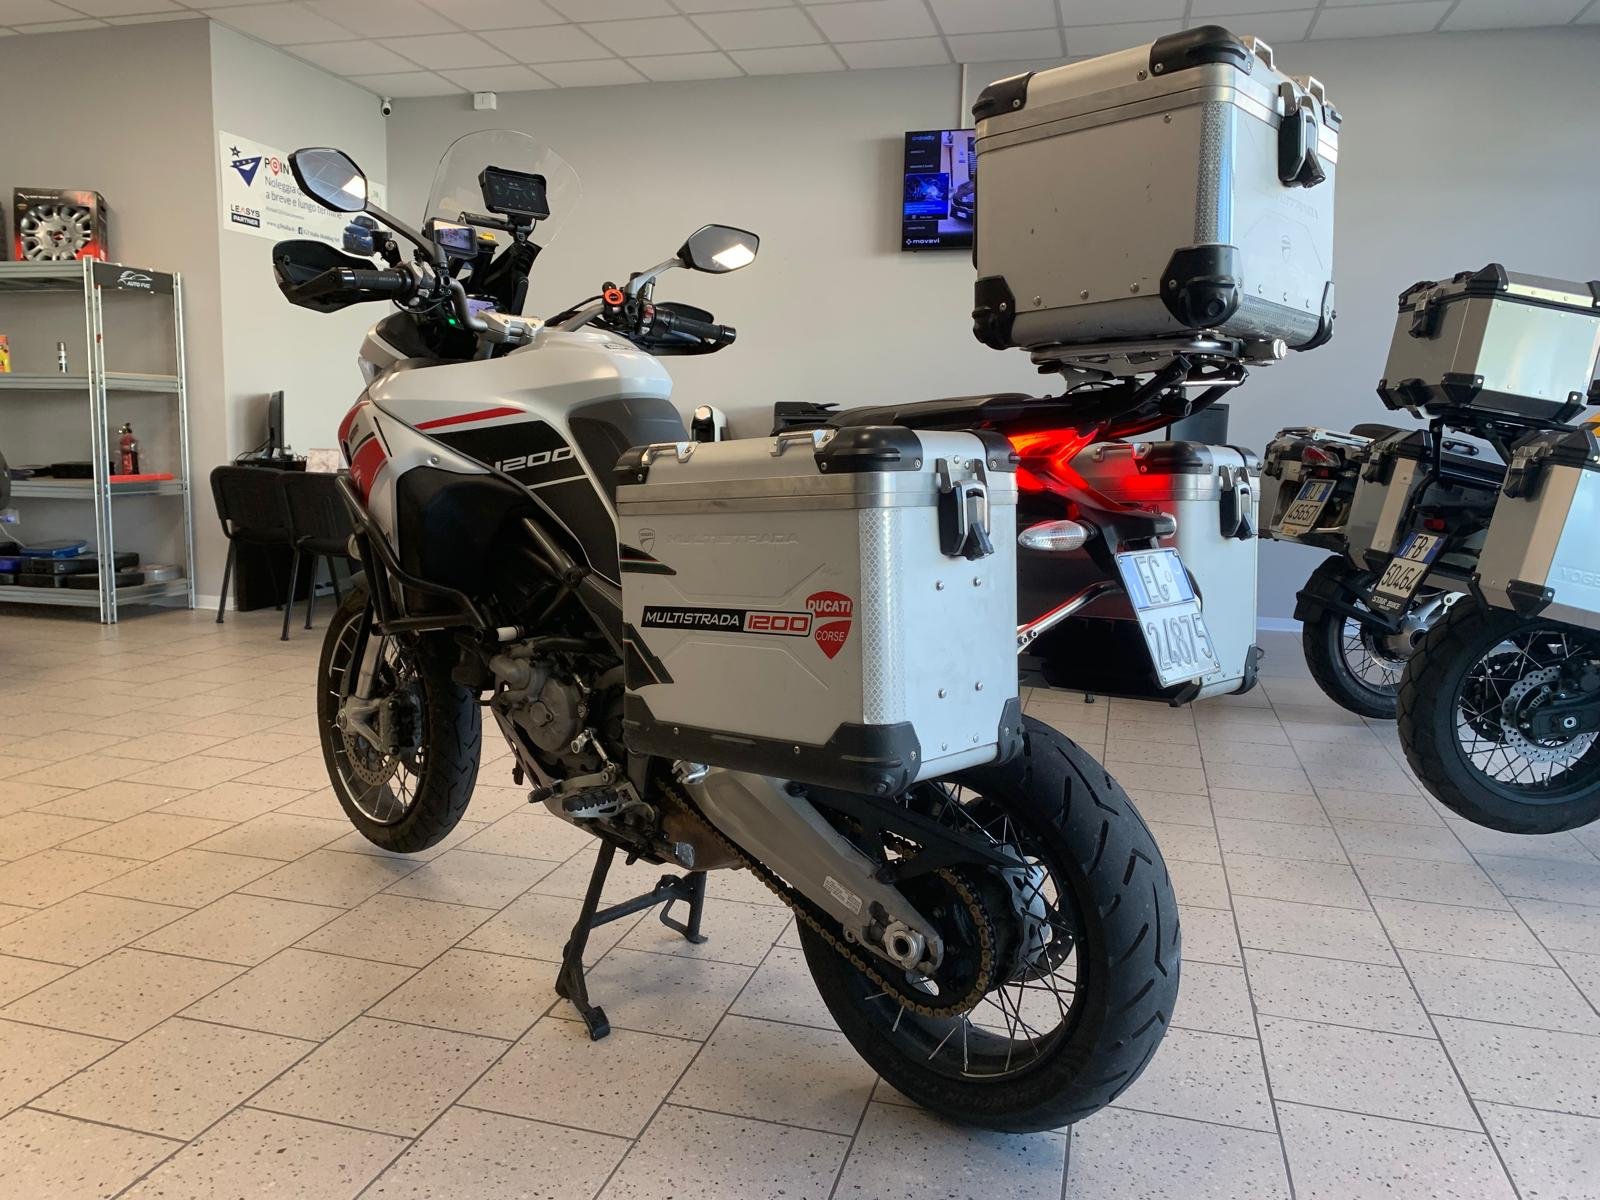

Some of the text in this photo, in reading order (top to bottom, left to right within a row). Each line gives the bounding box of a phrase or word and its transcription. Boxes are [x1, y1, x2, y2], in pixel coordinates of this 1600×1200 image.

[264, 157, 291, 176] POIN
[265, 176, 296, 195] Noleggia
[230, 204, 260, 218] LEASYS
[271, 191, 292, 205] breve
[298, 199, 316, 213] lungo
[495, 446, 576, 473] 1200
[1404, 535, 1429, 558] FB
[1133, 556, 1170, 605] EG
[1381, 563, 1423, 592] 50464
[808, 599, 853, 613] DUCATI
[645, 611, 808, 632] MULTISTRADA 1200
[815, 624, 847, 642] CORSE
[1146, 612, 1213, 671] 24875
